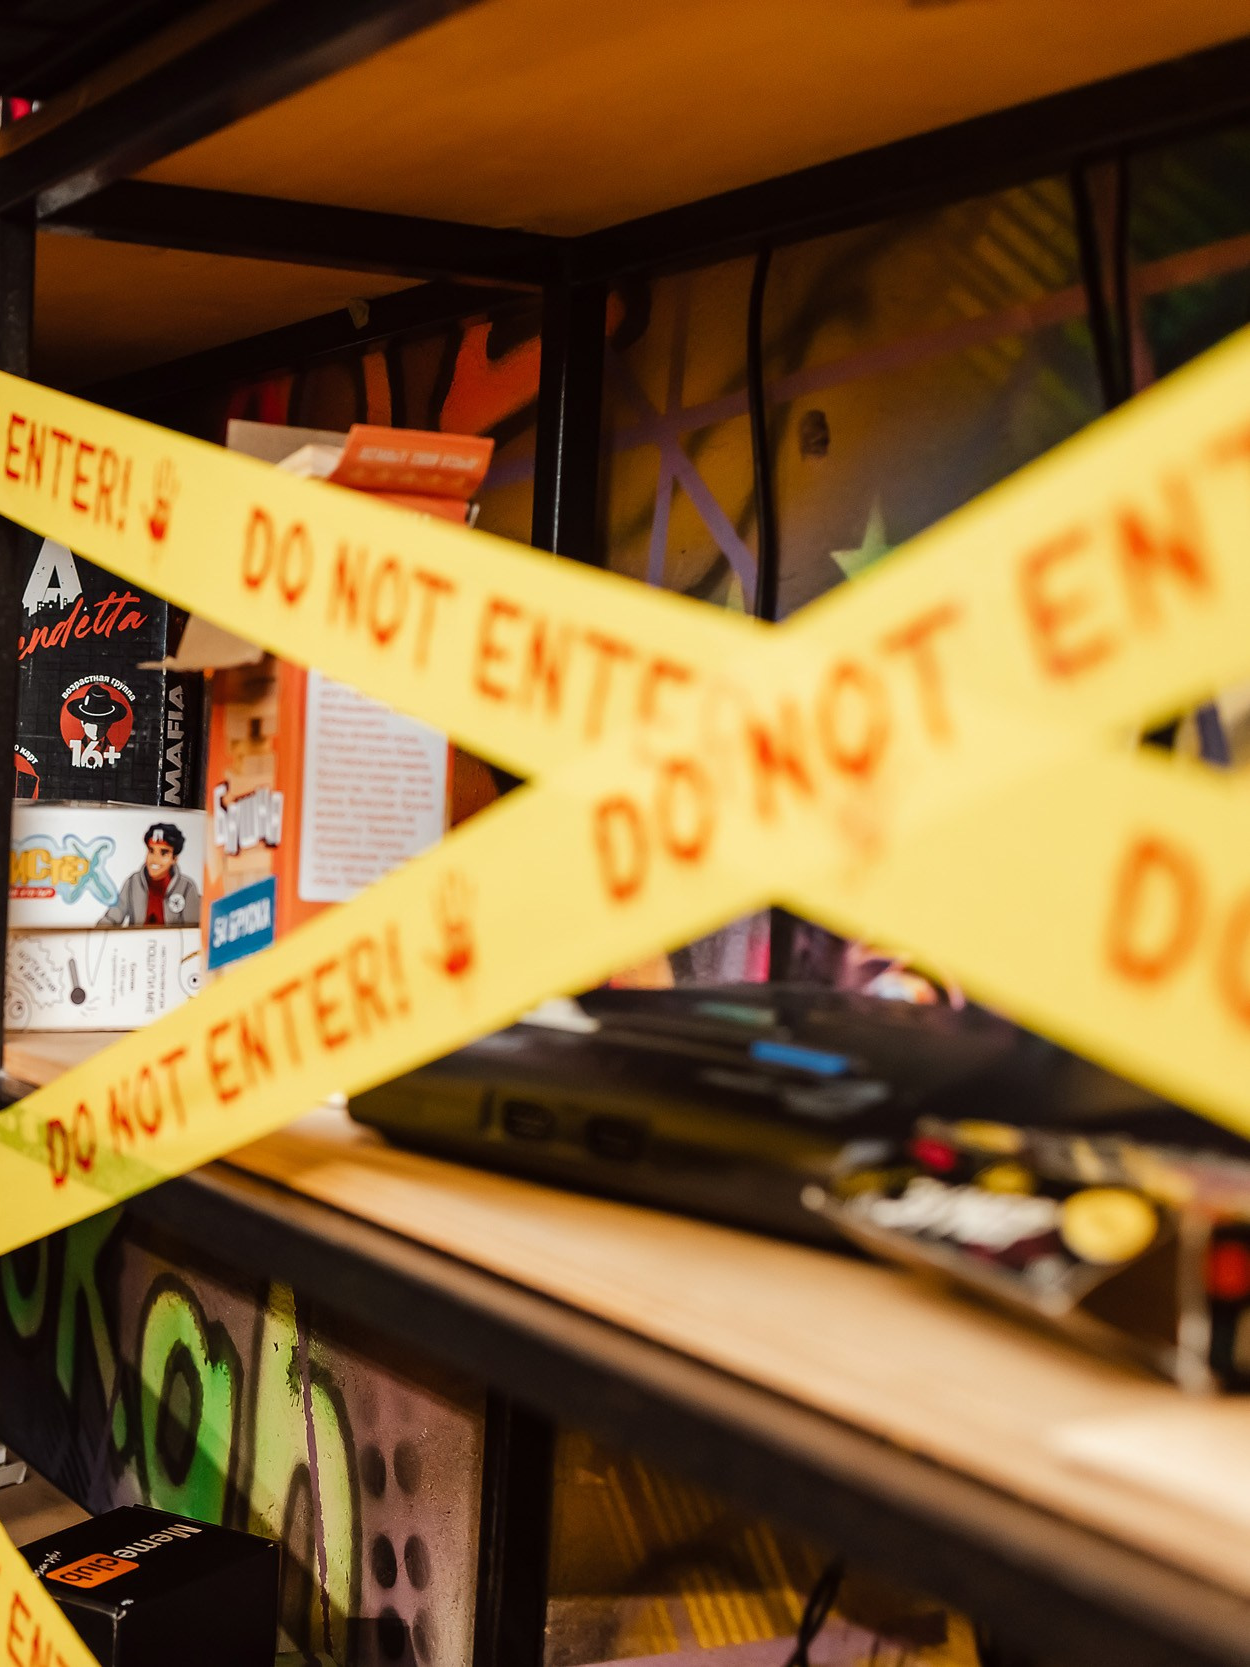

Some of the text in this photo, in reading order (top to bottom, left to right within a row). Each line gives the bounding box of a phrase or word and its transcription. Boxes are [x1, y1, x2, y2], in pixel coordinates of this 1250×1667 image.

[5, 412, 132, 530] ENTER!
[242, 503, 314, 607] DO
[327, 538, 460, 673] NOT
[61, 675, 136, 702] возрастная группа
[19, 746, 39, 765] карт
[69, 739, 121, 769] 16+
[164, 685, 185, 805] MAFIA
[47, 1102, 97, 1188] DO
[108, 1045, 190, 1156] NOT
[207, 920, 412, 1107] ENTER!
[592, 755, 718, 906] DO
[745, 596, 967, 828] NOT
[59, 1524, 202, 1581] Meme club
[6, 1590, 72, 1667] EN
